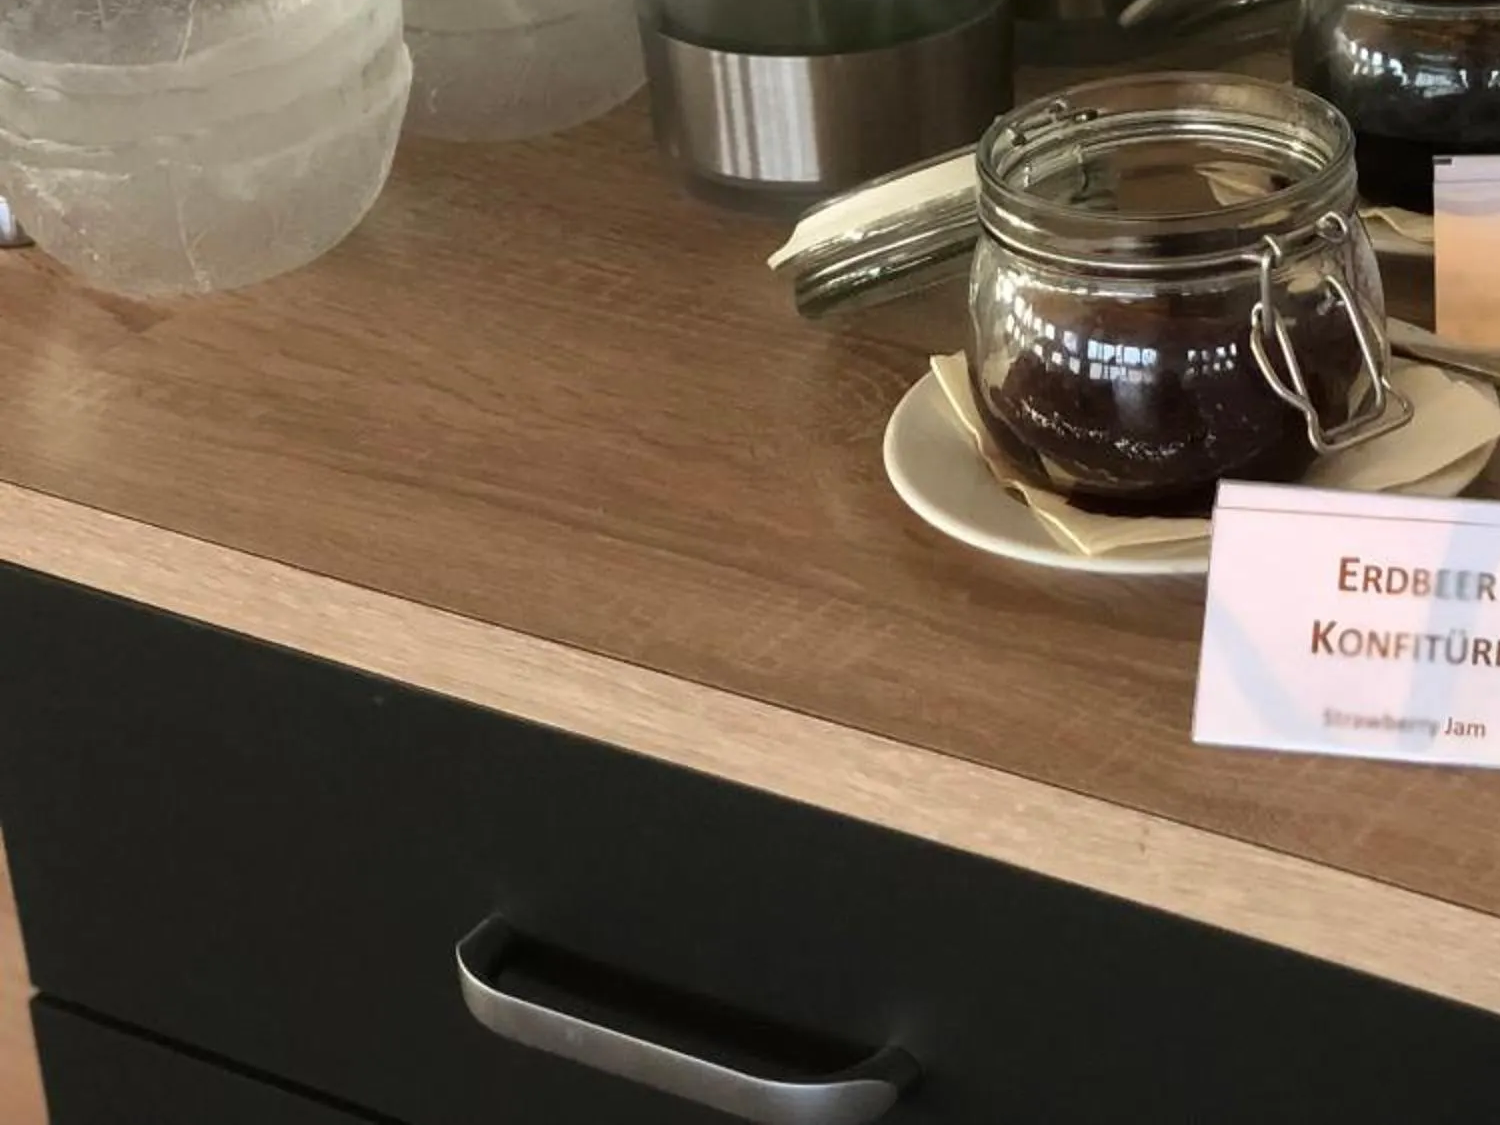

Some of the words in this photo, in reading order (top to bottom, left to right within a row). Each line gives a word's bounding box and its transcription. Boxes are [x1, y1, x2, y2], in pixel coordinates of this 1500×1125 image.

[1337, 556, 1497, 602] ERDBEER
[1322, 707, 1440, 739] Strawberry
[1444, 715, 1487, 739] Jam
